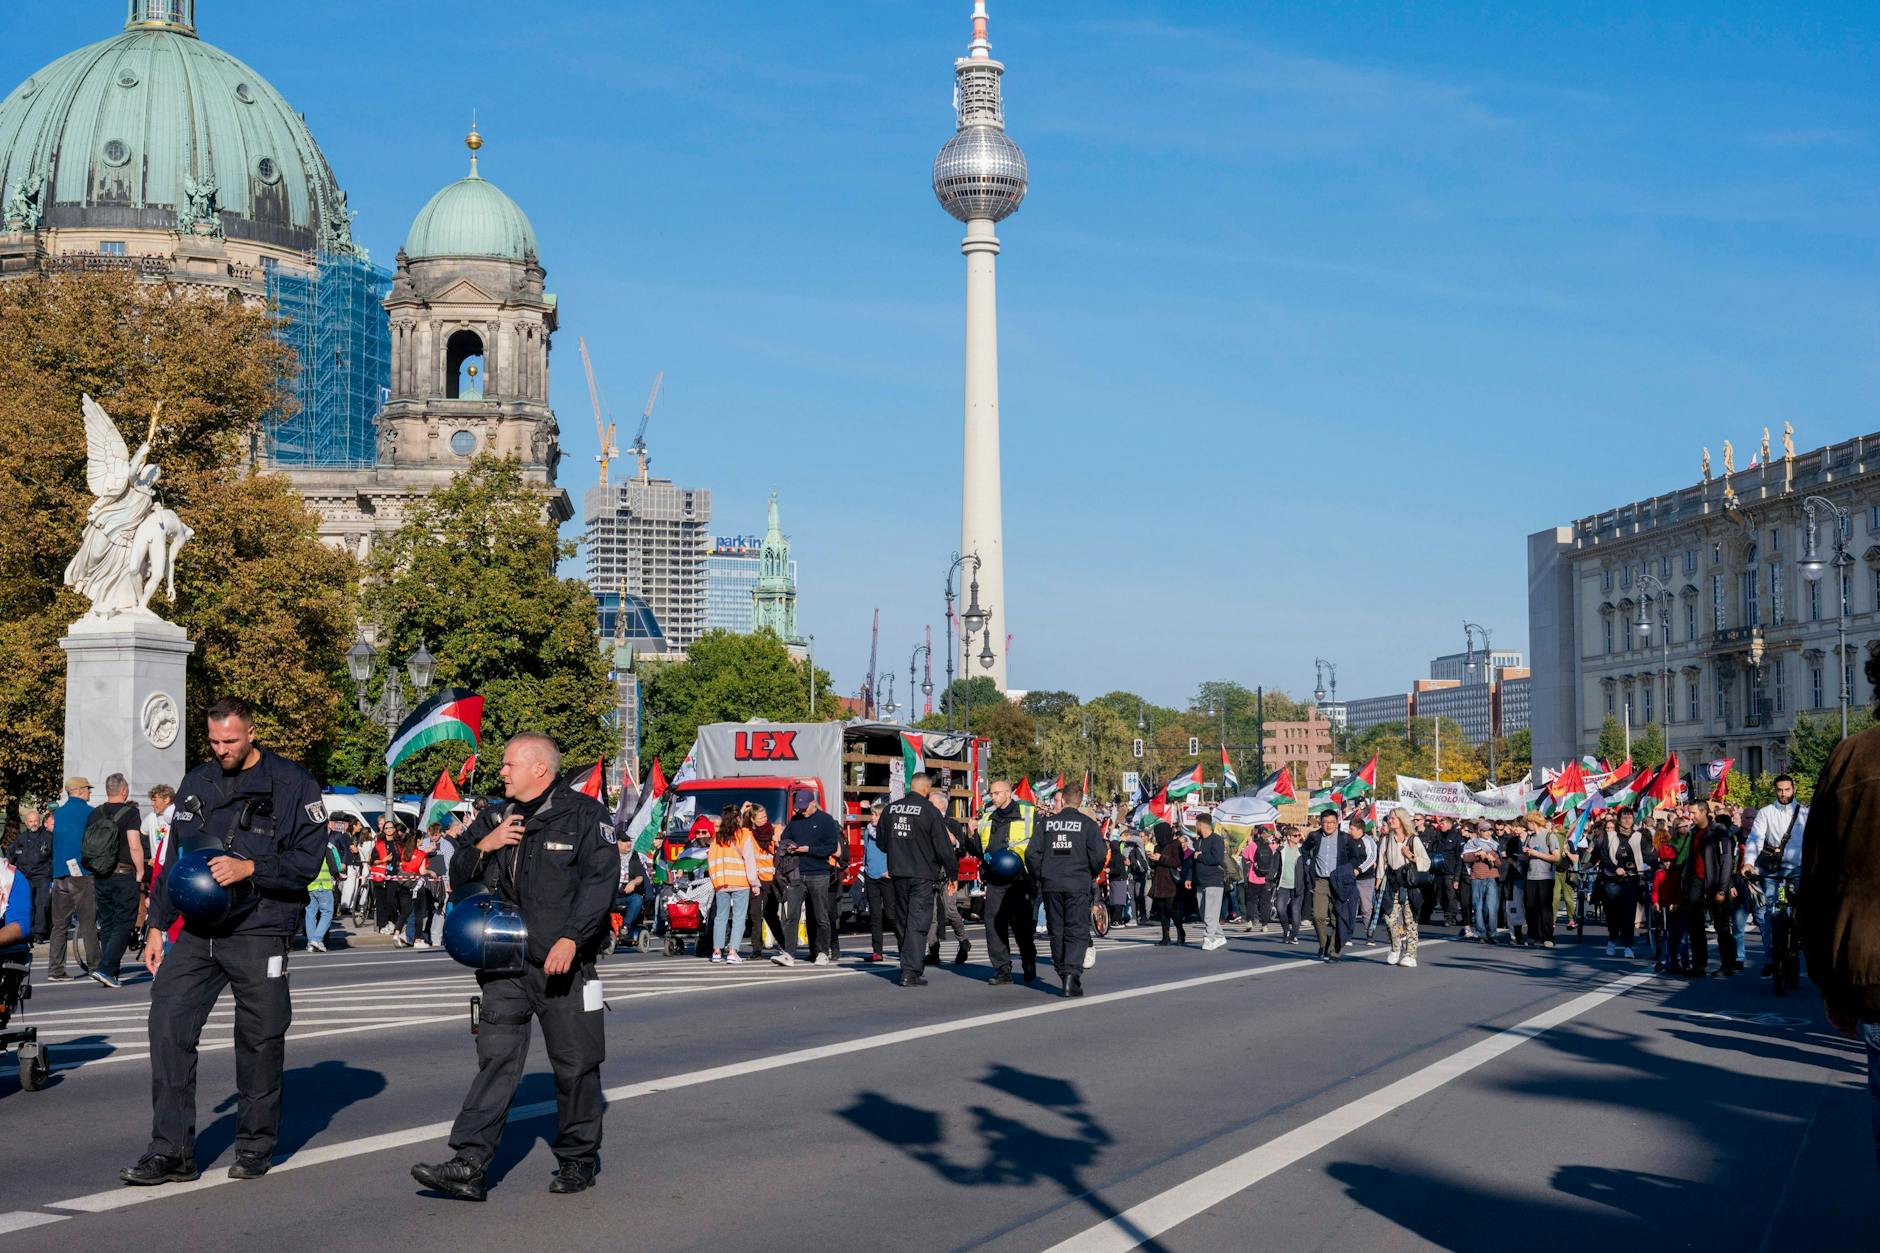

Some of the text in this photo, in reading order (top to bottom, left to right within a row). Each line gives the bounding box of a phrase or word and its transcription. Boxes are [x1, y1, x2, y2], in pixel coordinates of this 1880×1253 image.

[716, 535, 764, 553] park in
[735, 731, 799, 761] LEX
[1427, 786, 1458, 795] NIEDER
[889, 804, 922, 816] POLIZEI
[898, 816, 907, 824] BE
[1046, 820, 1082, 832] POLIZEI
[893, 823, 911, 831] 16311
